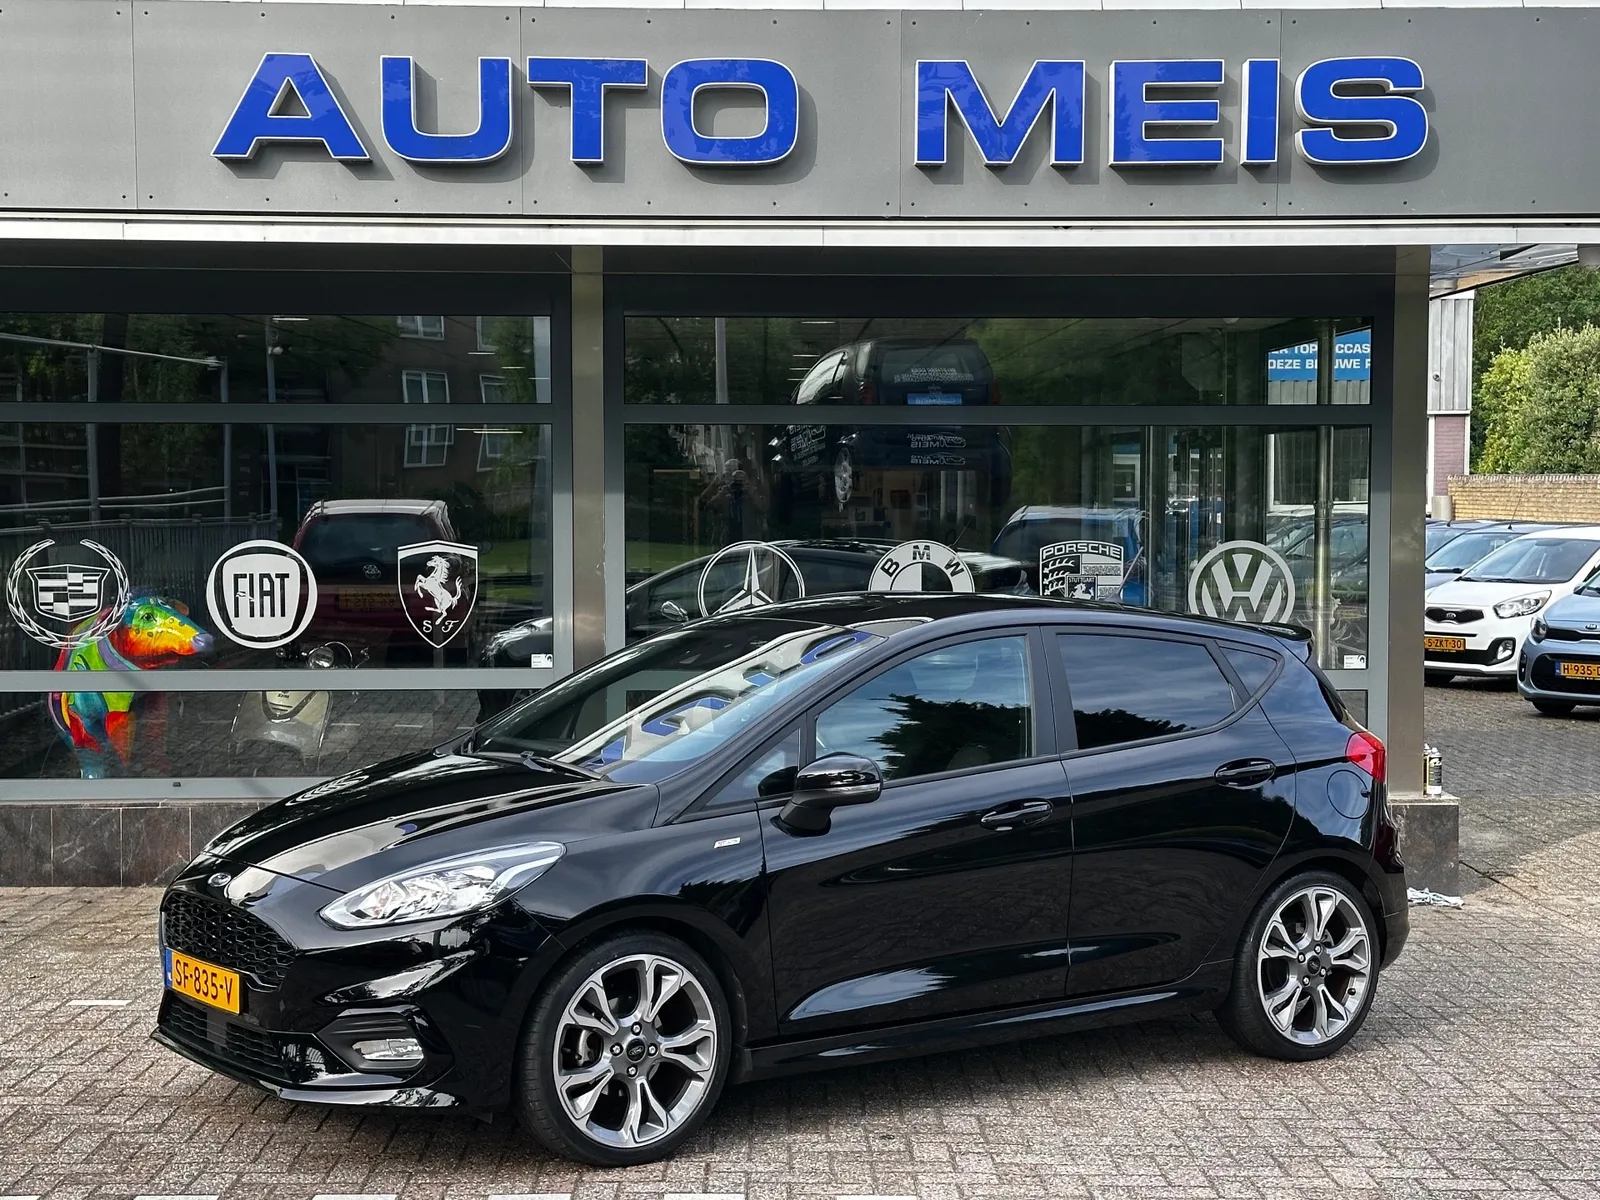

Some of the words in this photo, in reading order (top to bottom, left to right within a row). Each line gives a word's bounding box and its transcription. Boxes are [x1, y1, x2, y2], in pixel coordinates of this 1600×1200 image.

[211, 52, 799, 166] AUTO
[914, 56, 1430, 167] MEIS
[880, 545, 965, 577] BMW
[1043, 543, 1121, 560] PORSCHE
[233, 573, 290, 618] FIAT
[175, 959, 233, 1004] SF-835-V
